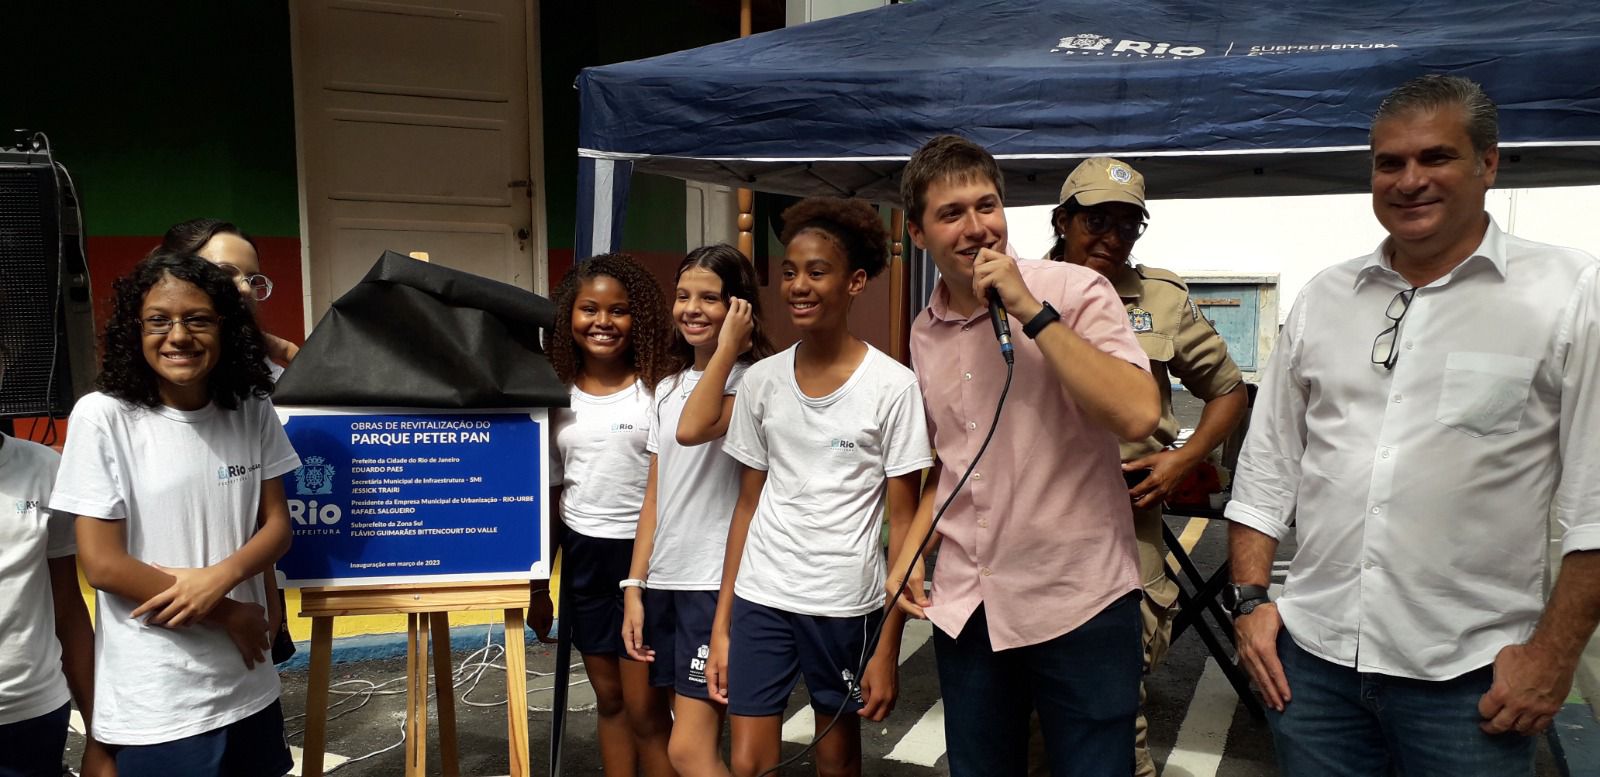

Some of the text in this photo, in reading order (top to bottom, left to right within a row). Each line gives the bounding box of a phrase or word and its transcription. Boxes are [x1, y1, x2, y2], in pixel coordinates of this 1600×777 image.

[1113, 40, 1205, 56] Rio
[351, 422, 383, 430] OBRAS
[400, 420, 473, 429] REVITALIZAÇÃO
[351, 432, 489, 445] PARQUE PETER PAN
[840, 440, 854, 448] Rio
[228, 465, 246, 477] Rio
[287, 500, 341, 525] Rio
[351, 561, 385, 569] Inauguração
[690, 658, 706, 670] Ri
